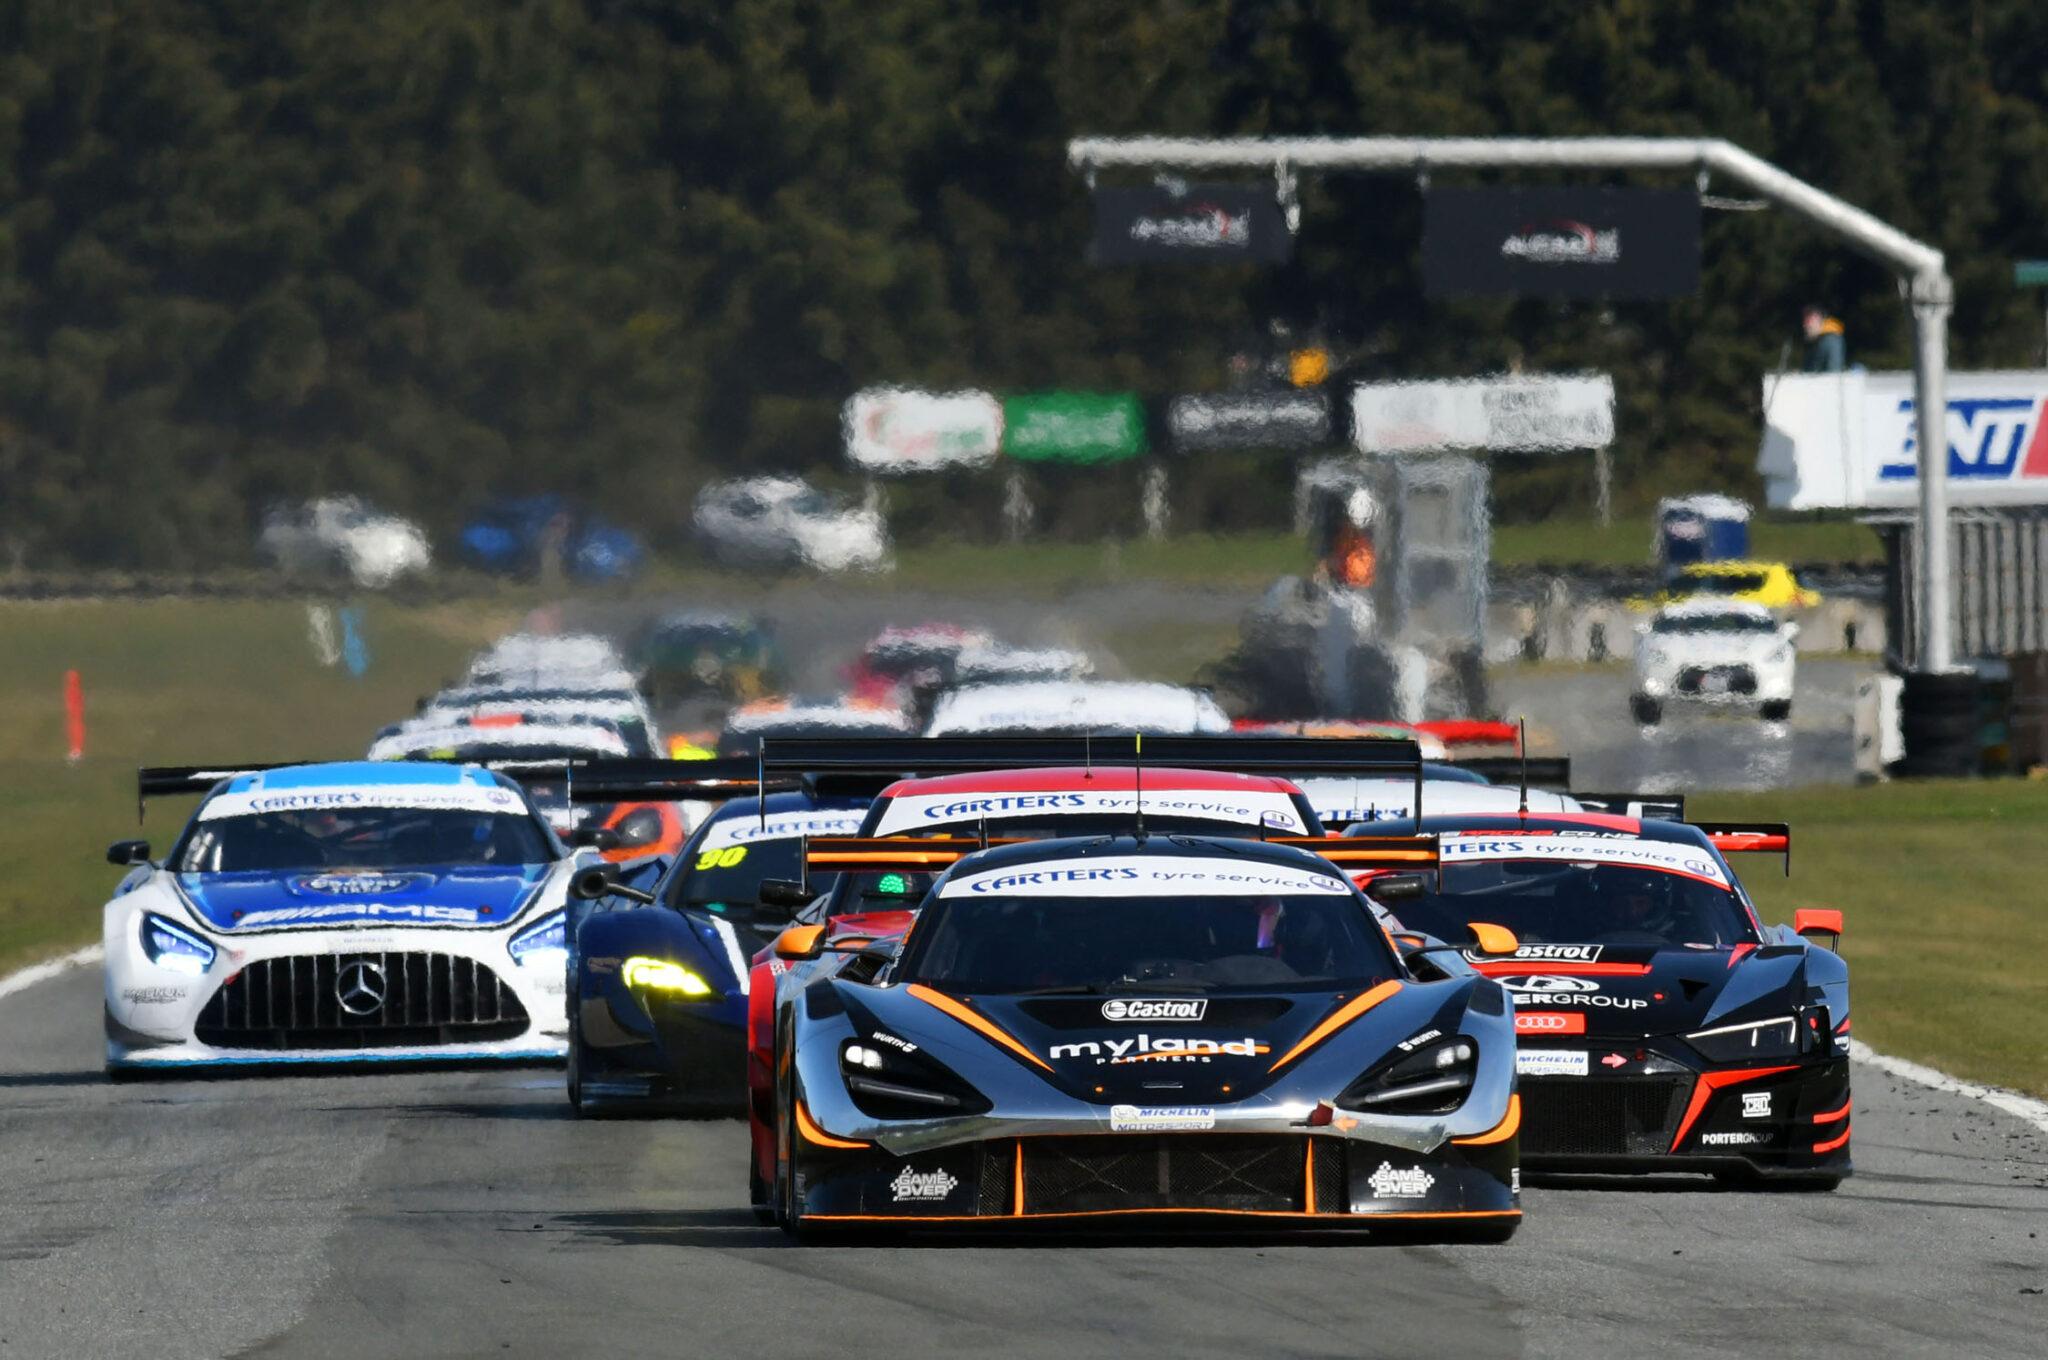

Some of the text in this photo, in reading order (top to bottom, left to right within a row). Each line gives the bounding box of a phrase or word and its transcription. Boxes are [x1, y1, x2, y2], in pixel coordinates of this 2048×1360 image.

[924, 794, 1250, 819] CARTER'S tyre service
[695, 846, 748, 871] 90
[1441, 841, 1677, 863] TER'S tyre service
[971, 868, 1139, 892] CARTER'S
[1152, 871, 1205, 881] tyre
[1215, 872, 1311, 889] service
[325, 903, 478, 922] AMG
[1515, 944, 1591, 960] astrol
[1512, 993, 1648, 1010] ERGROUP
[1128, 1001, 1198, 1018] Castrol
[1050, 1034, 1256, 1060] myland
[1096, 1055, 1212, 1065] PARTNERS
[1518, 1056, 1585, 1065] MICHELIN
[1139, 1107, 1211, 1117] MICHELIN
[1117, 1121, 1212, 1132] MOTORSPORT
[1702, 1131, 1774, 1145] PORTERGROUP
[898, 1172, 949, 1185] GAME
[1376, 1169, 1425, 1182] GAME
[897, 1184, 949, 1197] OVER
[1376, 1181, 1427, 1194] OVER
